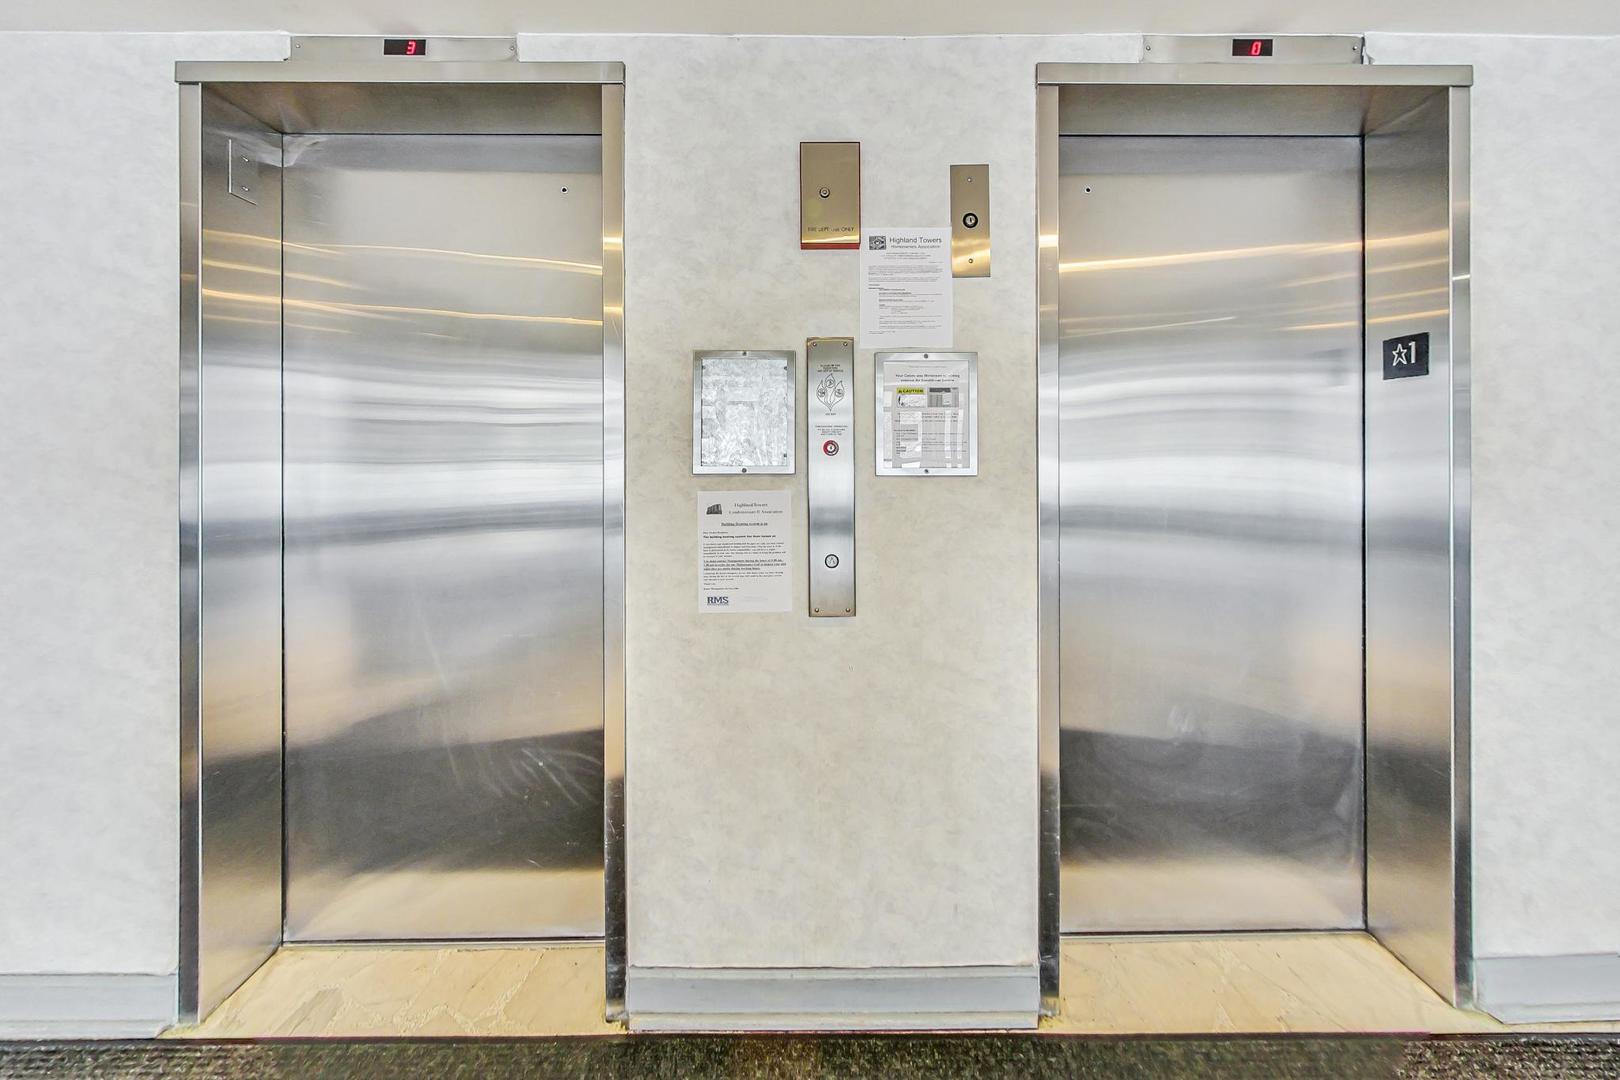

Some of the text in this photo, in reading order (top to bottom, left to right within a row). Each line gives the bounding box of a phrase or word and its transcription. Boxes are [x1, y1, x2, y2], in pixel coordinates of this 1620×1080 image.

[406, 41, 416, 54] 3
[1252, 41, 1262, 55] 0
[889, 236, 918, 244] Highland
[1408, 341, 1416, 364] 1
[706, 596, 729, 604] RMS
